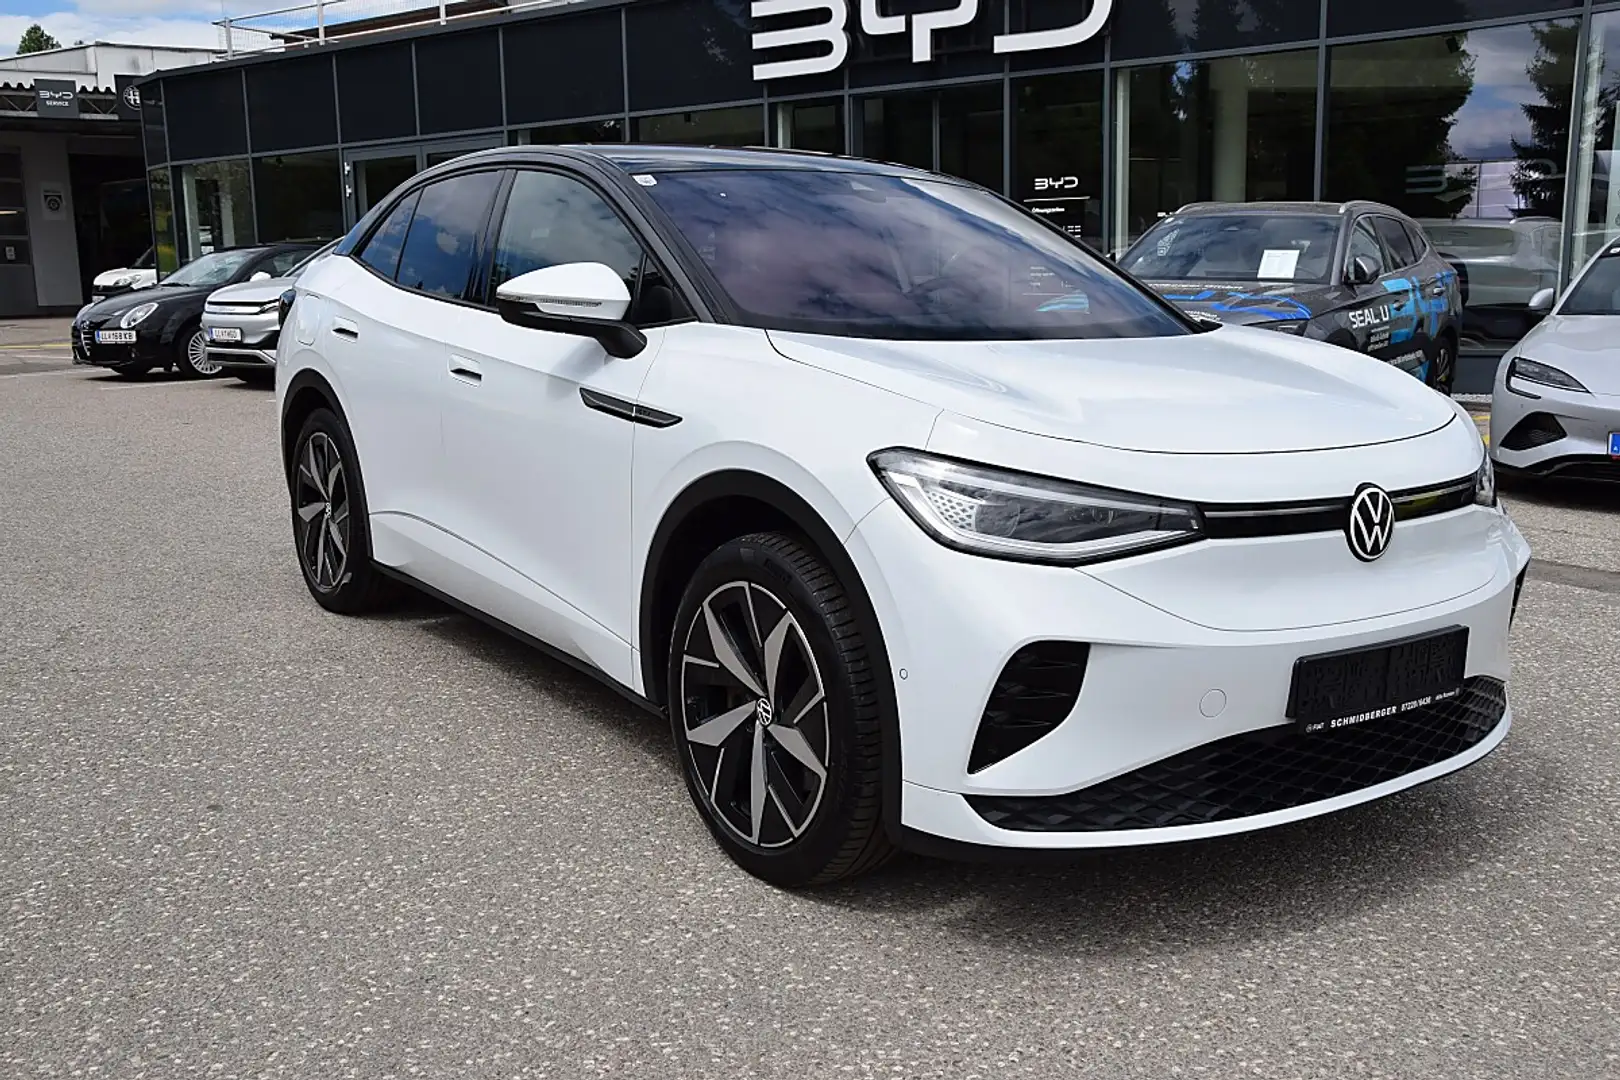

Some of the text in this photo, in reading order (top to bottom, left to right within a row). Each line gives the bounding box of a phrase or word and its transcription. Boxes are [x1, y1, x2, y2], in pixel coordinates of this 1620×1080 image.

[39, 90, 74, 99] BYD
[1034, 176, 1078, 190] BYD
[1348, 304, 1390, 328] SEAL U
[1330, 705, 1398, 729] SCHMIDBERGER
